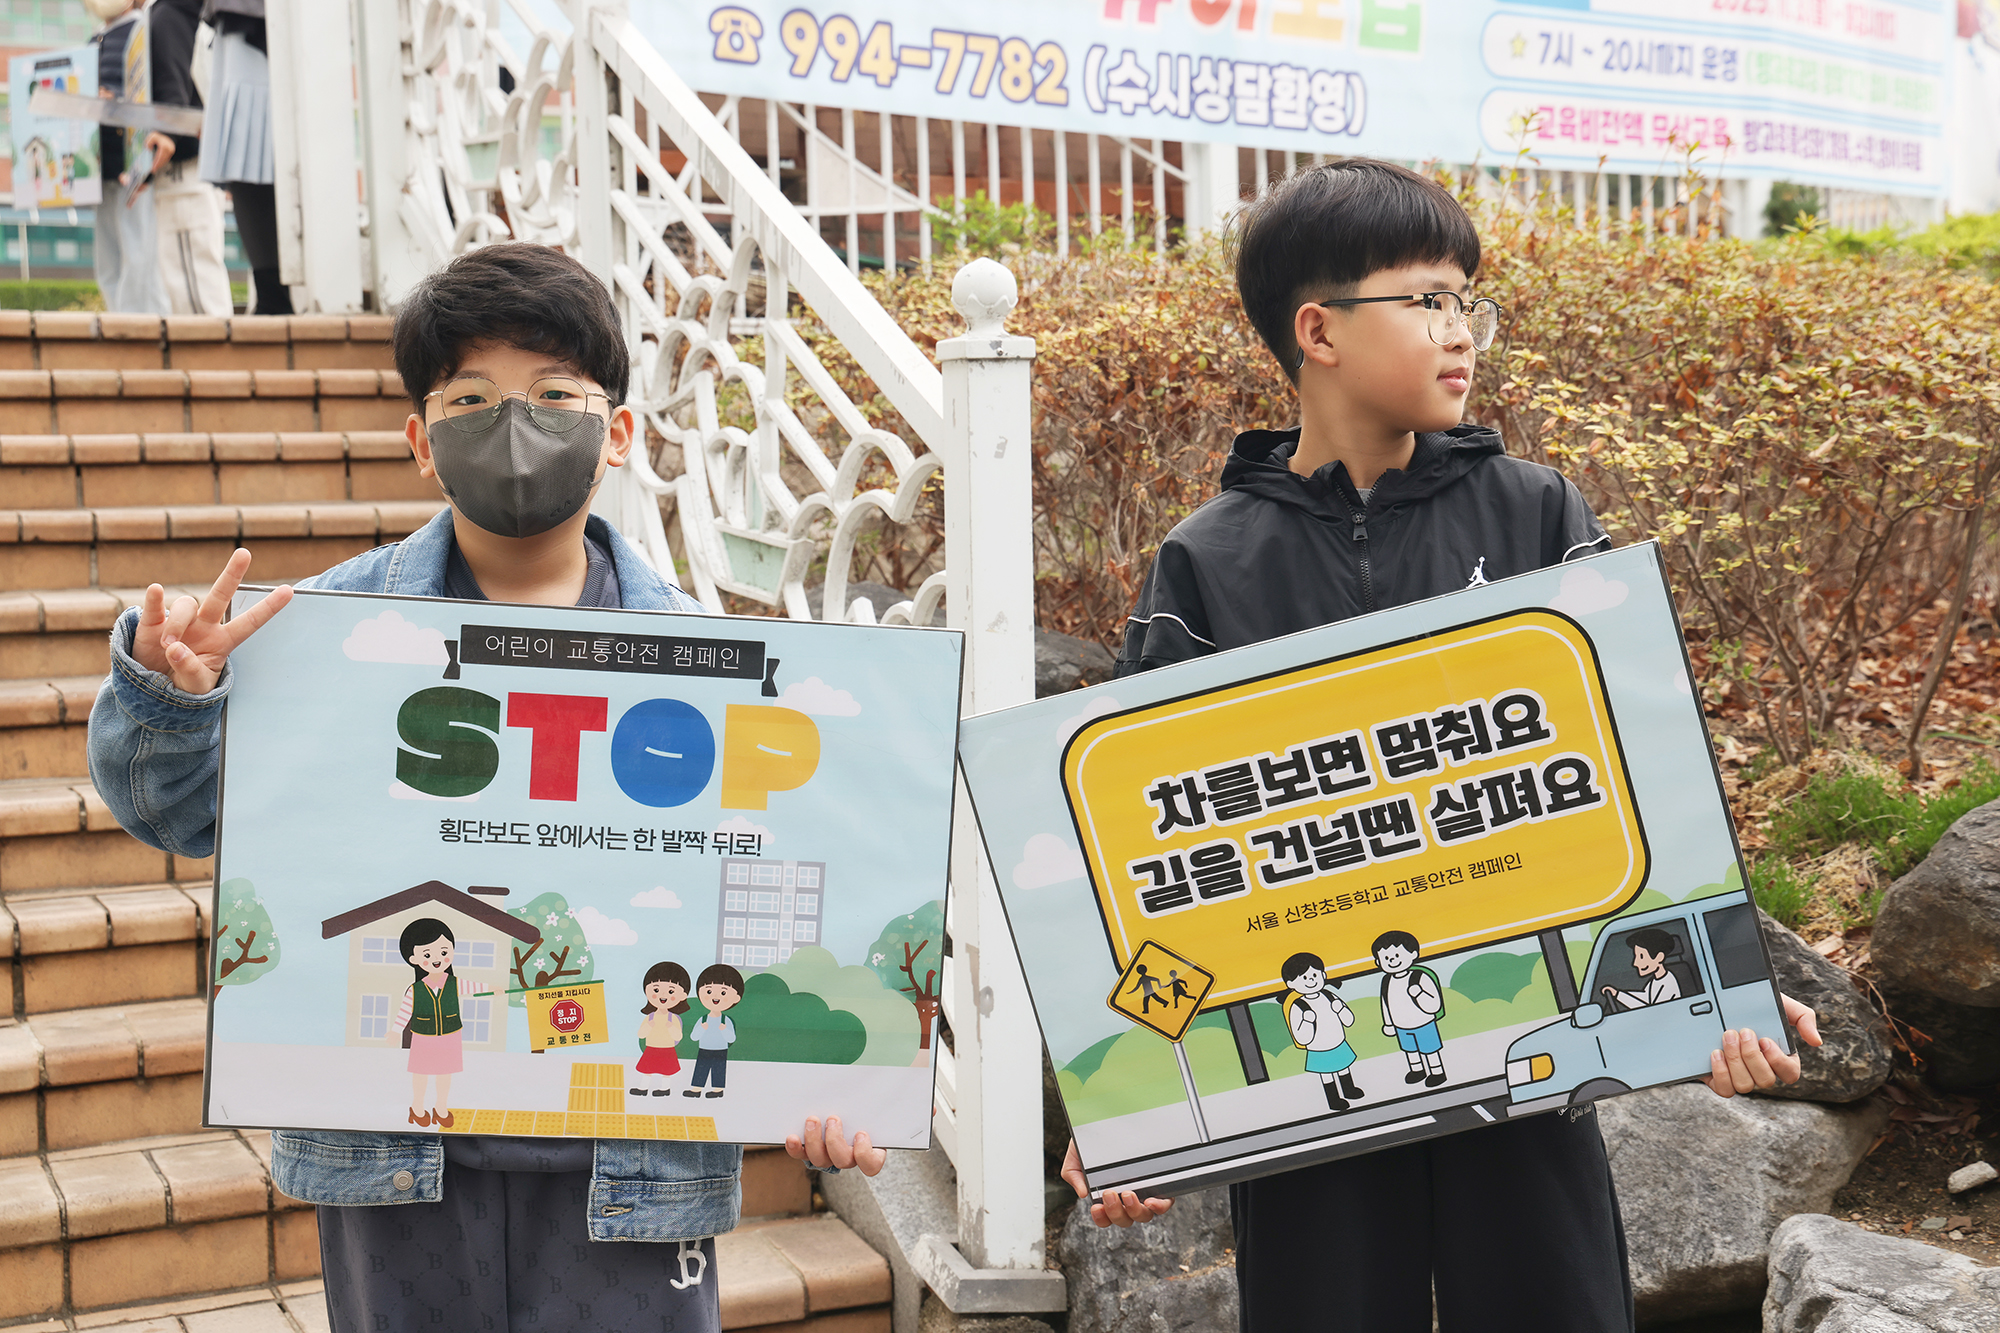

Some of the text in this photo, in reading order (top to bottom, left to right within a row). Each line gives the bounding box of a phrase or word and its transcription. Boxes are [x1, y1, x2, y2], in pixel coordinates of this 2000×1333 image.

[779, 8, 1069, 107] 994-7782
[1084, 43, 1367, 137] (수시상담환영)
[1538, 32, 1573, 67] 7시
[1603, 39, 1694, 76] 20시까지
[1703, 46, 1738, 82] 운영
[484, 635, 741, 670] 어린이 교통안전 캠페인
[396, 686, 821, 811] STOP
[1149, 694, 1551, 835] 차를보면 멈춰요
[439, 818, 762, 857] 횡단보도 앞에서는 한 발짝 뒤로!
[1132, 757, 1601, 914] 길을 건널땐 살펴요
[1246, 852, 1523, 934] 서울 신창초등학교 교통안전 캠페인
[558, 1016, 577, 1024] STOP
